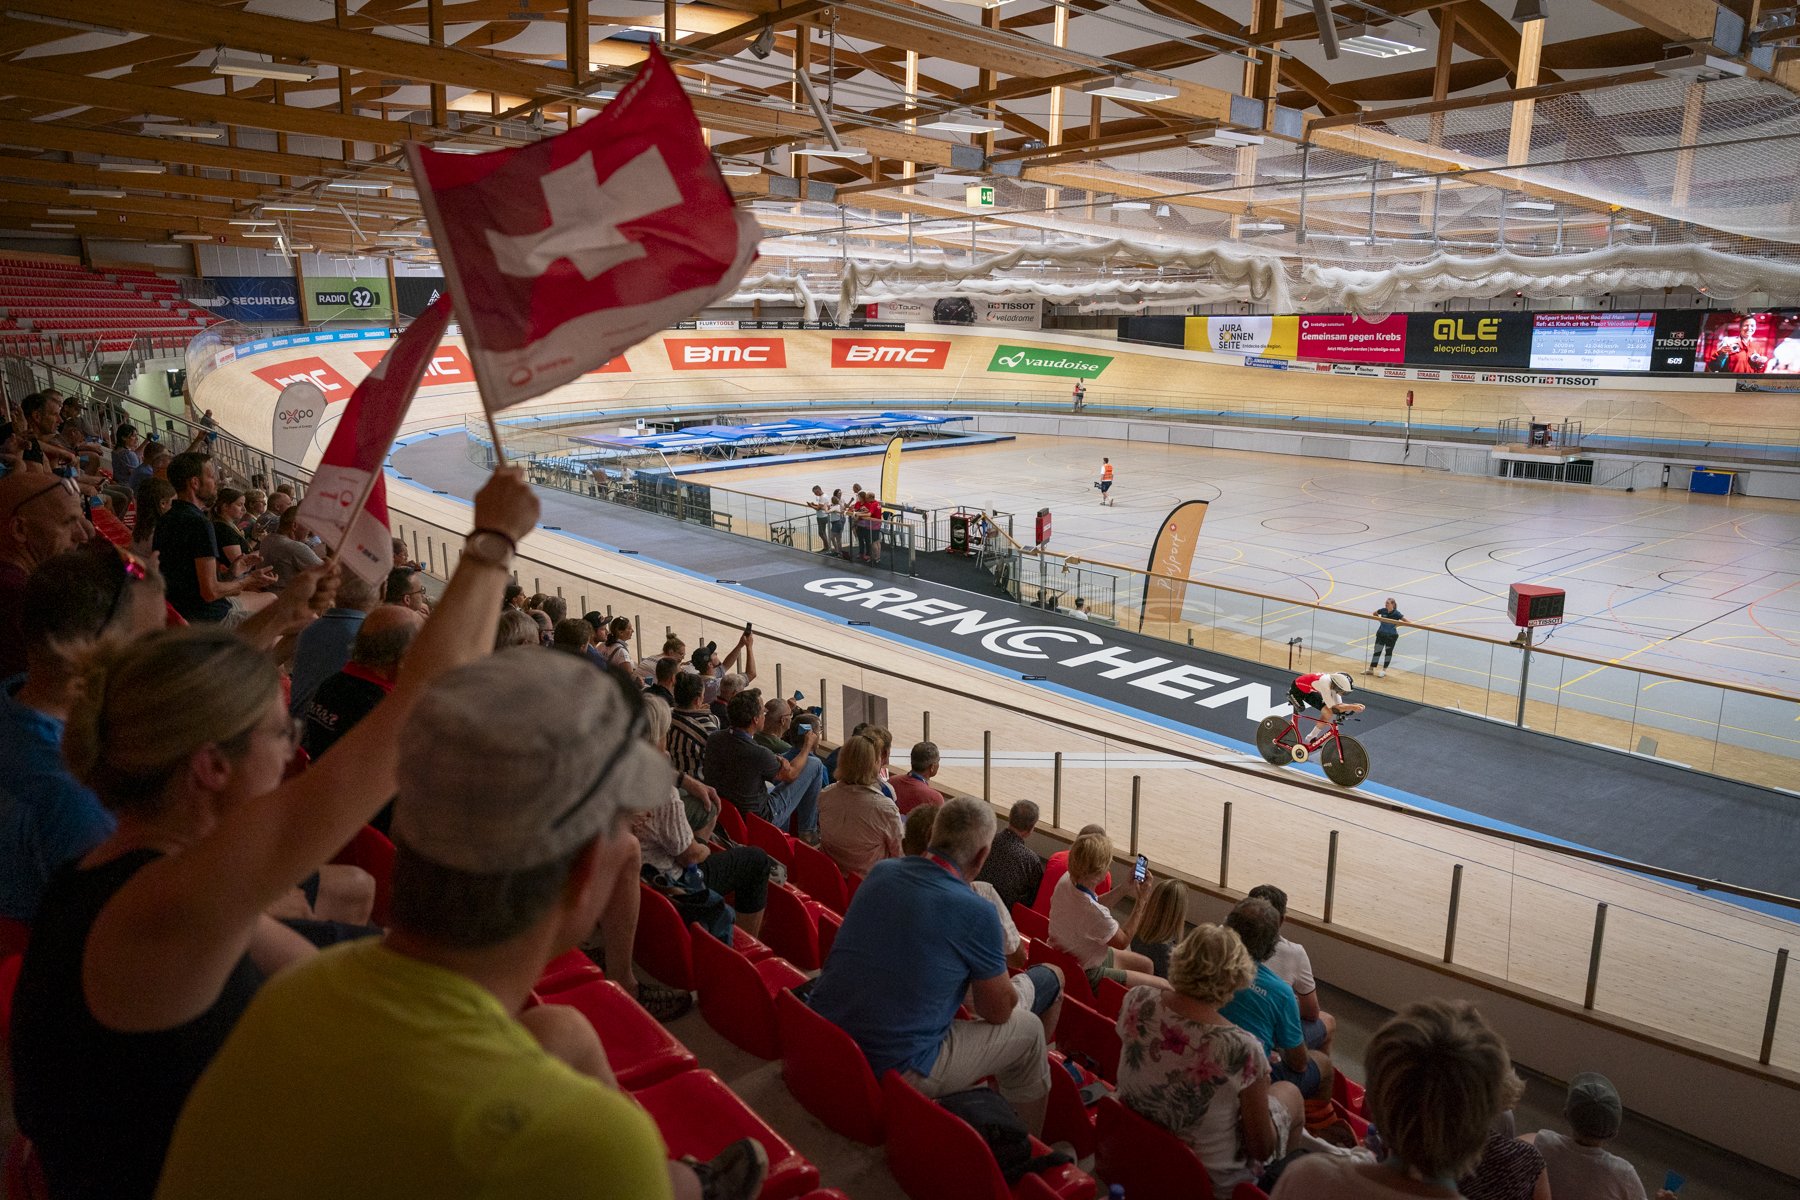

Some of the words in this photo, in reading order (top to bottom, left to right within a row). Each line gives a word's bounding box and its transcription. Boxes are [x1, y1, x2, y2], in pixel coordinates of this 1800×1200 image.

[232, 296, 295, 305] SECURITAS
[318, 294, 346, 303] RADIO
[352, 290, 371, 307] 32
[1000, 302, 1035, 310] TISSOT
[996, 315, 1034, 323] velodrome
[1219, 323, 1242, 332] JURA
[1219, 331, 1254, 341] SONNEN
[1301, 332, 1348, 341] Gemeinsam
[1348, 333, 1374, 342] gegen
[1376, 332, 1402, 341] Krebs
[1218, 341, 1241, 350] SEITE
[1655, 338, 1698, 347] TISSOT
[684, 345, 771, 363] BMC
[845, 345, 936, 362] BMC
[1433, 344, 1498, 355] alecycling.com
[1024, 358, 1099, 372] vaudoise
[1497, 374, 1538, 384] TISSOT
[1555, 376, 1599, 386] TISSOT
[278, 408, 314, 425] axpo
[803, 577, 1311, 722] GRENCHEN
